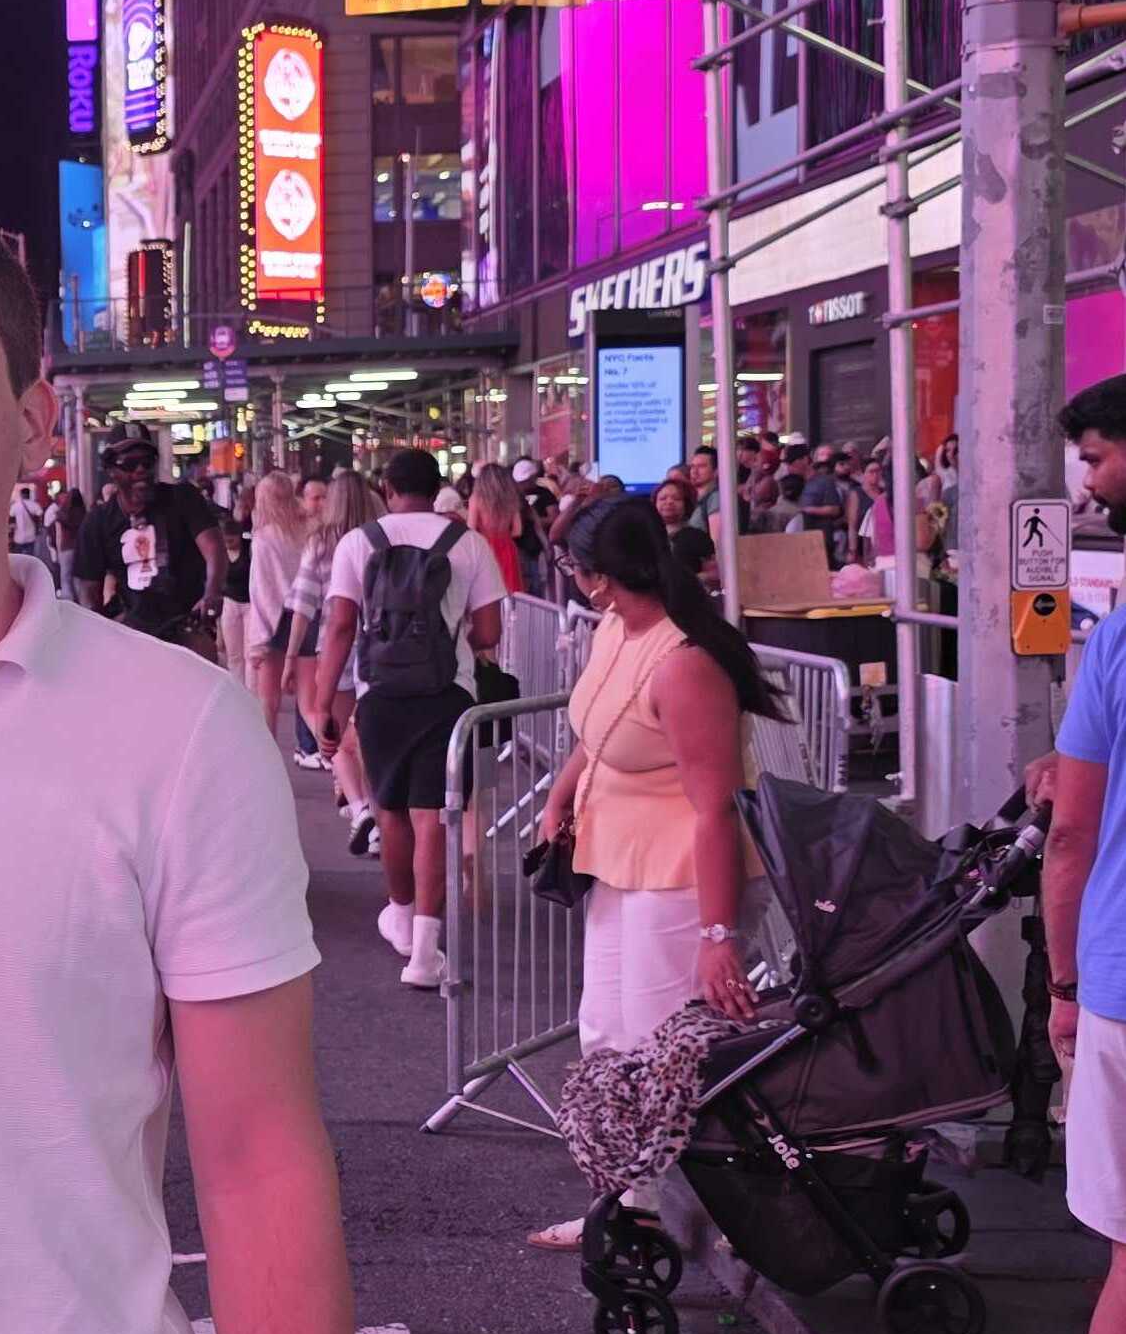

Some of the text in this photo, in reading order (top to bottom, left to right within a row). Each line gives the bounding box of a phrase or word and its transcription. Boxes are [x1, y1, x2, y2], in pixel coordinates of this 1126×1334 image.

[1032, 549, 1053, 557] PUSH
[1018, 557, 1066, 565] BUTTON FOR
[767, 1133, 800, 1170] Joie
